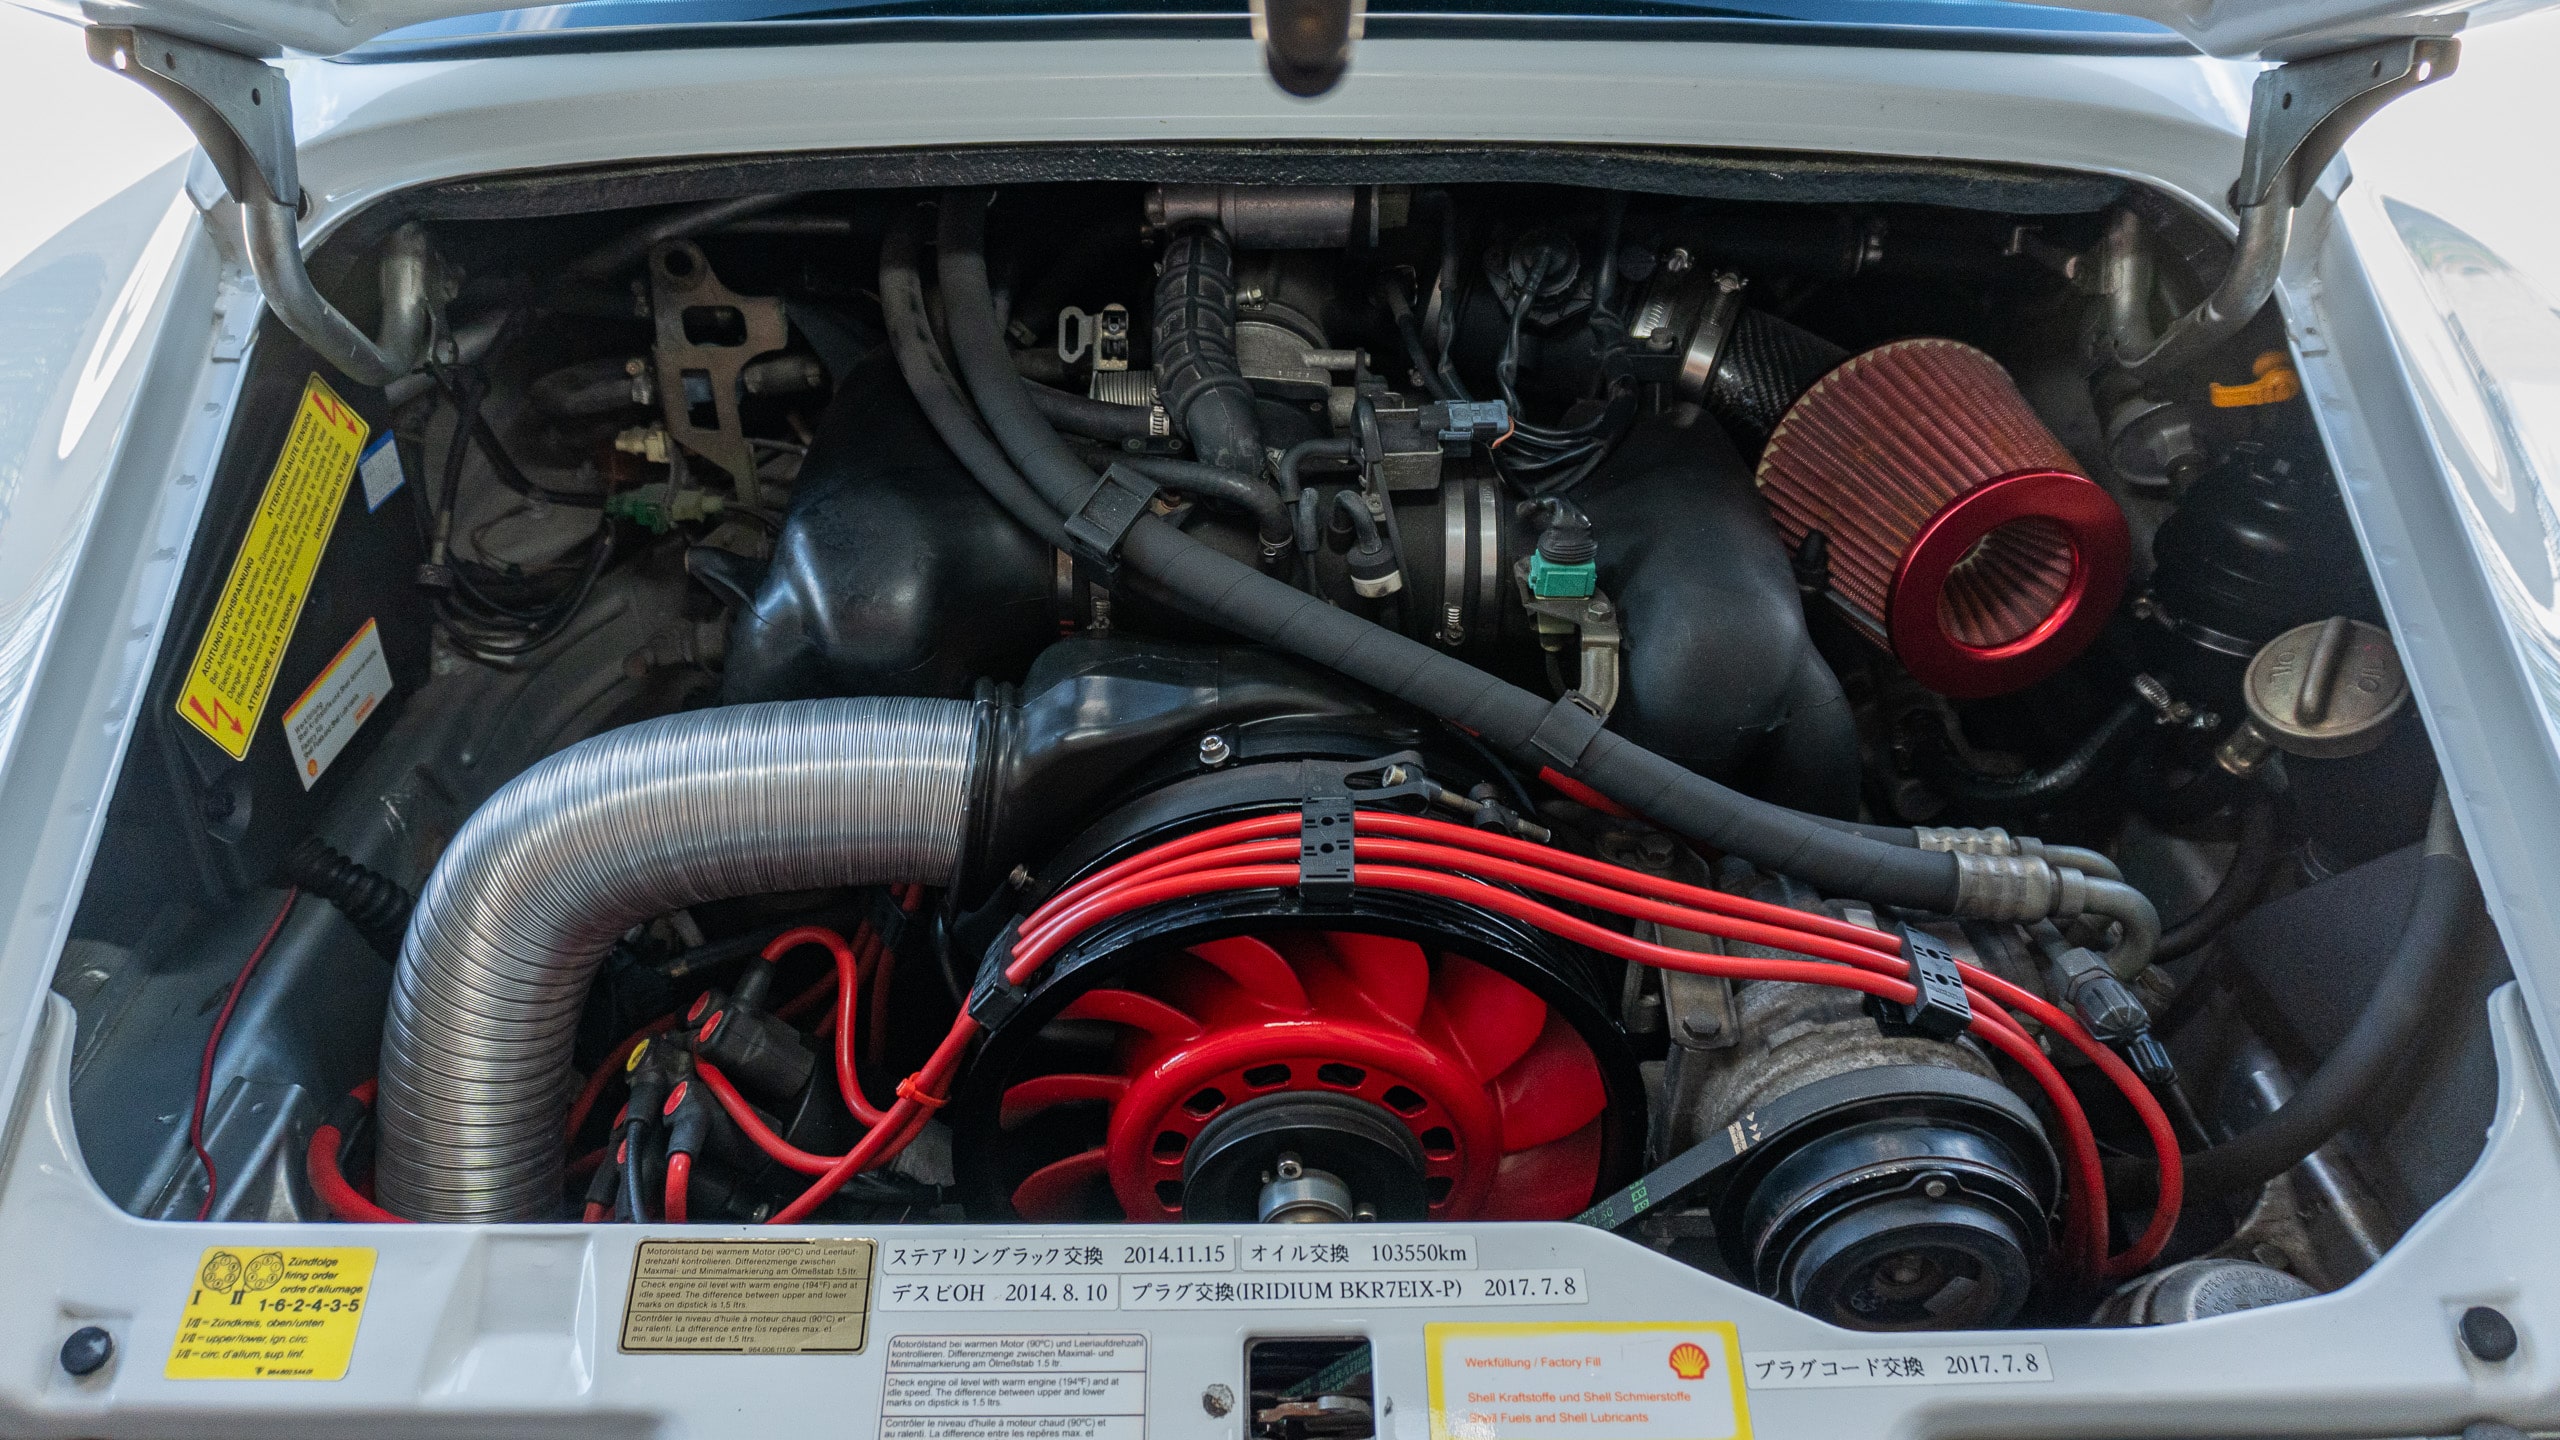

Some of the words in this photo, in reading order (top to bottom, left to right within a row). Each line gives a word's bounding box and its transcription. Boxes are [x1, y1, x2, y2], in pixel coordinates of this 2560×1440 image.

[266, 471, 288, 518] ATTENTION
[284, 444, 299, 473] HAUTE
[295, 410, 312, 445] TENSION
[313, 505, 330, 540] DANGER
[326, 485, 337, 506] HIGH
[201, 629, 224, 677] ACHTUNG
[219, 555, 254, 631] HOCHSPANNUNG
[246, 657, 271, 712] ATTENZIONE
[277, 592, 296, 634] TENSIONE
[751, 1247, 775, 1255] Motor
[805, 1247, 820, 1255] und
[891, 1246, 1104, 1265] ステアリングラック交換
[1124, 1246, 1225, 1264] 2014.11.15
[1252, 1244, 1349, 1263] オイル交換
[1373, 1244, 1466, 1262] 103550km
[287, 1257, 338, 1267] Zündfolge
[284, 1271, 309, 1280] firing
[311, 1271, 338, 1279] order
[280, 1285, 306, 1294] ordre
[641, 1280, 666, 1288] Check
[668, 1280, 695, 1289] engine
[709, 1280, 727, 1288] level
[730, 1280, 746, 1288] with
[773, 1281, 799, 1289] engine
[832, 1280, 847, 1289] and
[639, 1290, 653, 1298] idle
[685, 1290, 699, 1298] The
[702, 1290, 742, 1298] difference
[745, 1290, 779, 1299] between
[782, 1292, 805, 1300] upper
[807, 1290, 822, 1299] and
[825, 1291, 846, 1299] lower
[258, 1298, 359, 1311] 1-6-2-4-3-5
[637, 1300, 661, 1308] marks
[677, 1300, 707, 1309] dipstick
[685, 1314, 711, 1322] niveau
[781, 1315, 806, 1323] chaud
[1000, 1339, 1024, 1348] Motor
[1056, 1339, 1071, 1348] und
[947, 1350, 1013, 1359] Differenzmenge
[1016, 1349, 1055, 1358] zwischen
[1098, 1348, 1113, 1357] und
[1465, 1358, 1531, 1369] Werkfüllung
[1541, 1358, 1582, 1369] Factory
[1585, 1357, 1601, 1366] Fill
[1756, 1356, 1925, 1379] プラグコード交換
[888, 1377, 914, 1386] Check
[917, 1378, 944, 1386] engine
[960, 1377, 980, 1386] level
[982, 1377, 999, 1386] with
[1001, 1378, 1025, 1386] warm
[1027, 1378, 1056, 1386] engine
[1092, 1377, 1108, 1385] and
[936, 1387, 952, 1396] The
[954, 1387, 996, 1396] difference
[998, 1387, 1034, 1396] between
[1037, 1389, 1061, 1397] upper
[1063, 1387, 1079, 1396] and
[1082, 1387, 1105, 1396] lower
[1468, 1393, 1495, 1402] Shell
[1499, 1392, 1555, 1402] Kraftstoffe
[1560, 1393, 1580, 1402] und
[1584, 1392, 1611, 1402] Shell
[1615, 1392, 1691, 1402] Schmierstoffe
[886, 1398, 911, 1406] marks
[927, 1399, 959, 1407] dipstick
[1501, 1413, 1531, 1422] Fuels
[1535, 1413, 1555, 1422] and
[1559, 1413, 1587, 1422] Shell
[1591, 1412, 1649, 1422] Lubricants
[937, 1418, 965, 1427] niveau
[1006, 1418, 1036, 1427] moteur
[1038, 1418, 1065, 1427] chaud
[987, 1429, 1009, 1437] entre
